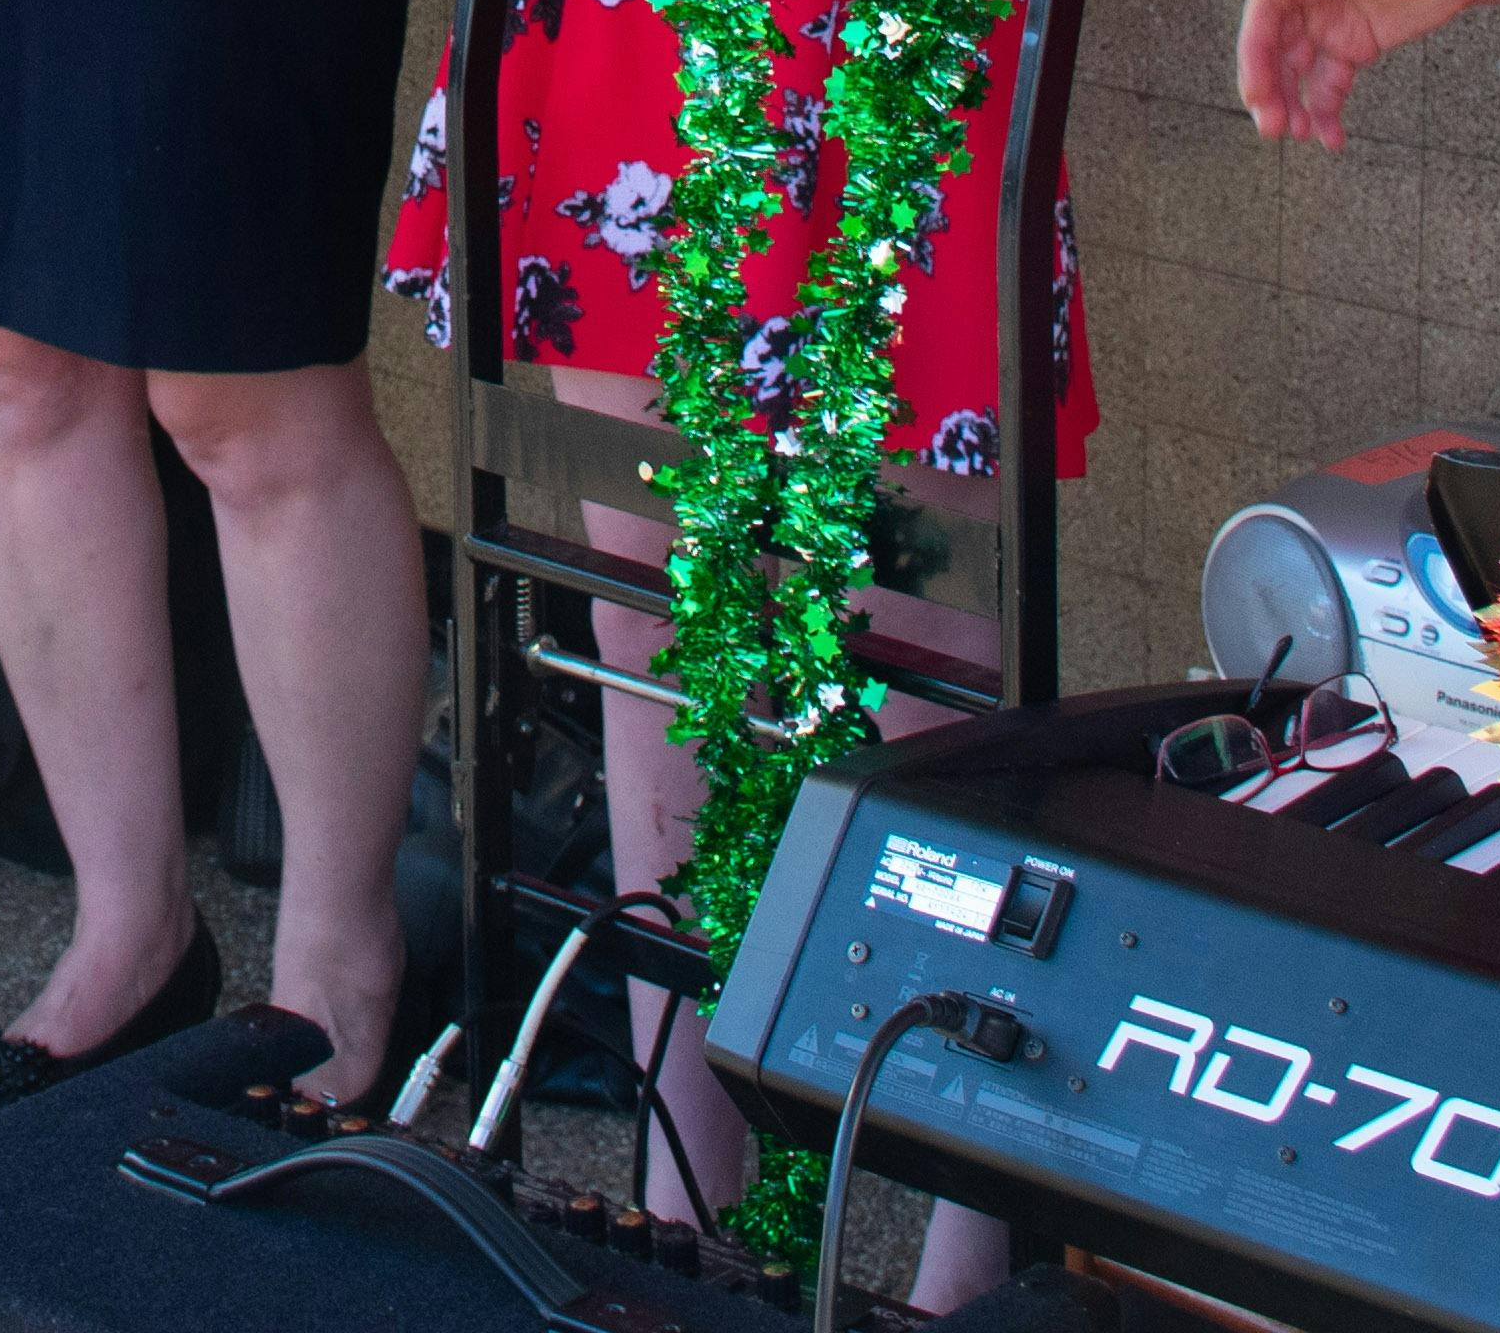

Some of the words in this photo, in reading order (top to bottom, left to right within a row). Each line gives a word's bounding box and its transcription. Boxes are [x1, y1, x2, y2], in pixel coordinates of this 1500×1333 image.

[907, 842, 957, 868] Roland
[1023, 854, 1059, 874] POWER
[1058, 865, 1077, 879] ON
